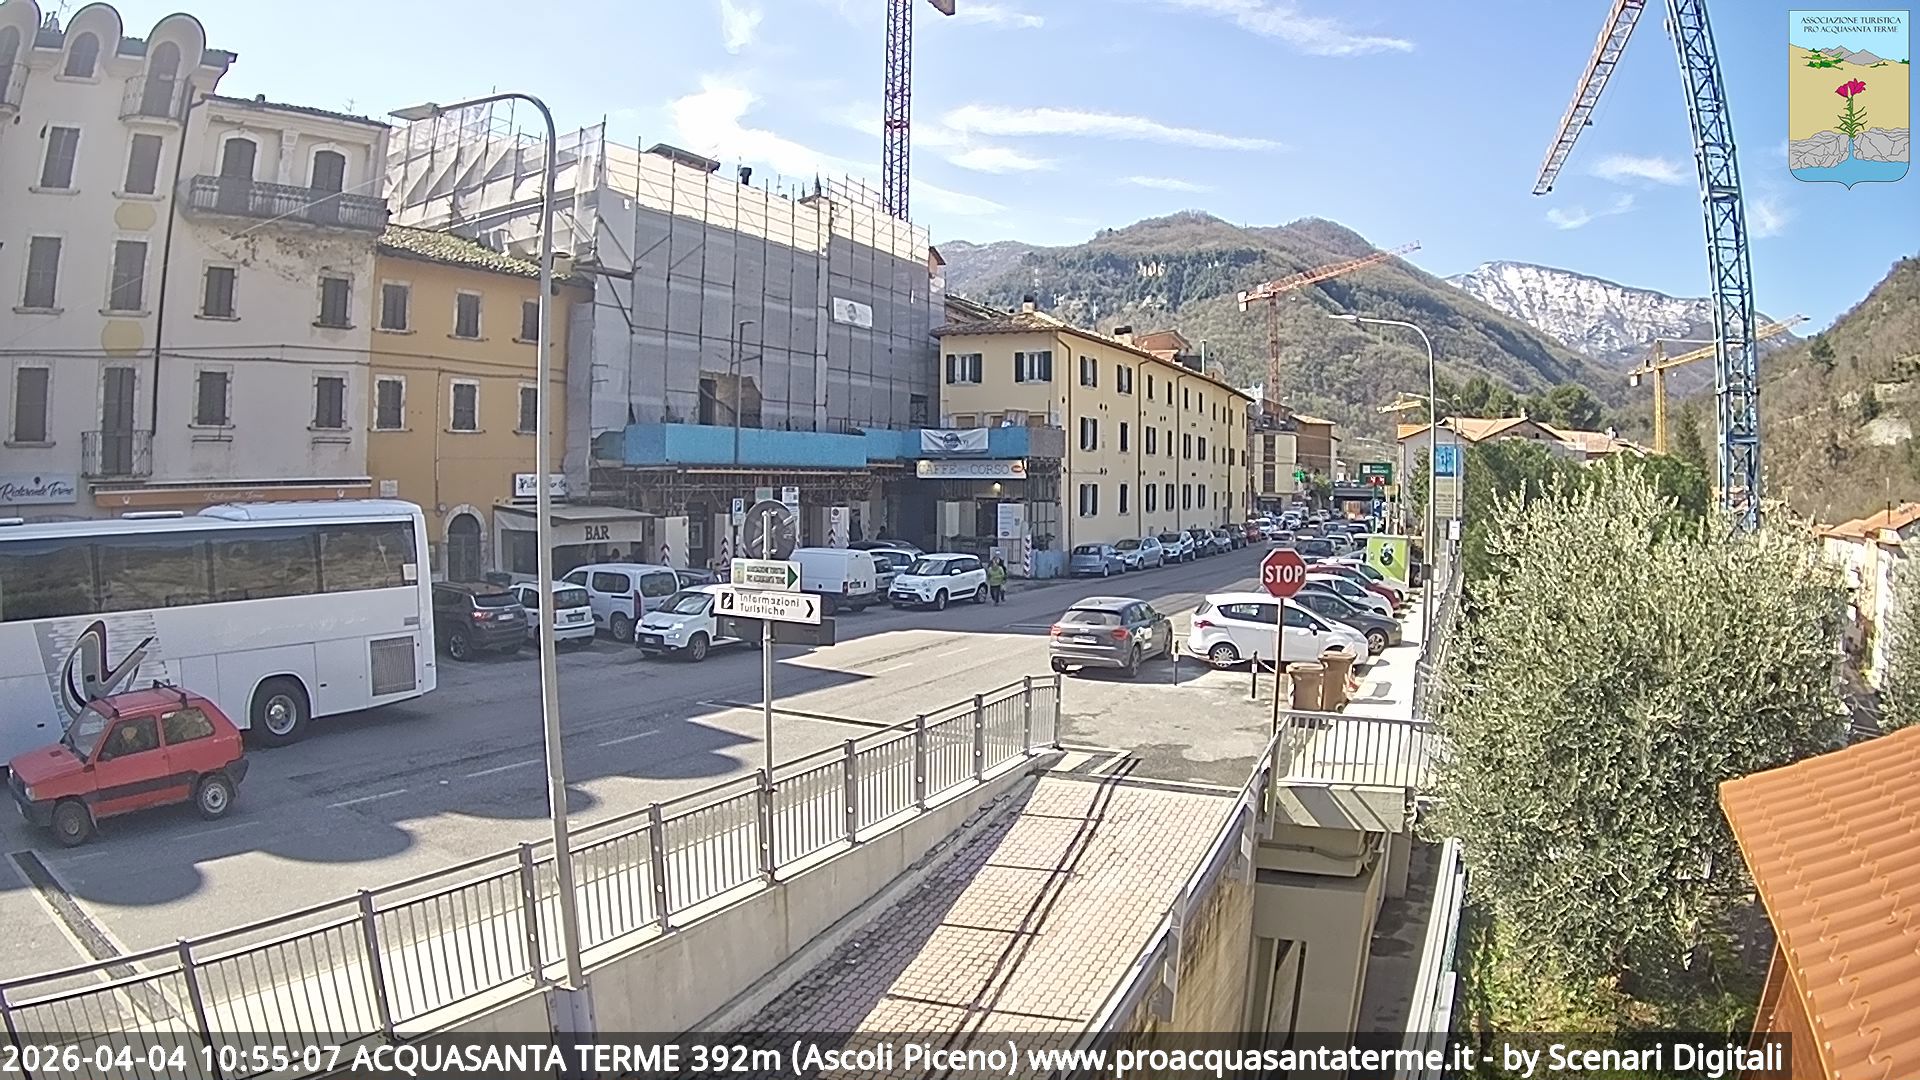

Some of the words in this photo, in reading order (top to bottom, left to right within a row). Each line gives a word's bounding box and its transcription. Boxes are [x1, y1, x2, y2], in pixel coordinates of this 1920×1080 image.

[969, 463, 1010, 475] CORSO
[585, 525, 610, 541] BAR
[1265, 565, 1304, 583] STOP
[740, 593, 800, 608] Informazioni
[740, 603, 785, 616] Turistiche
